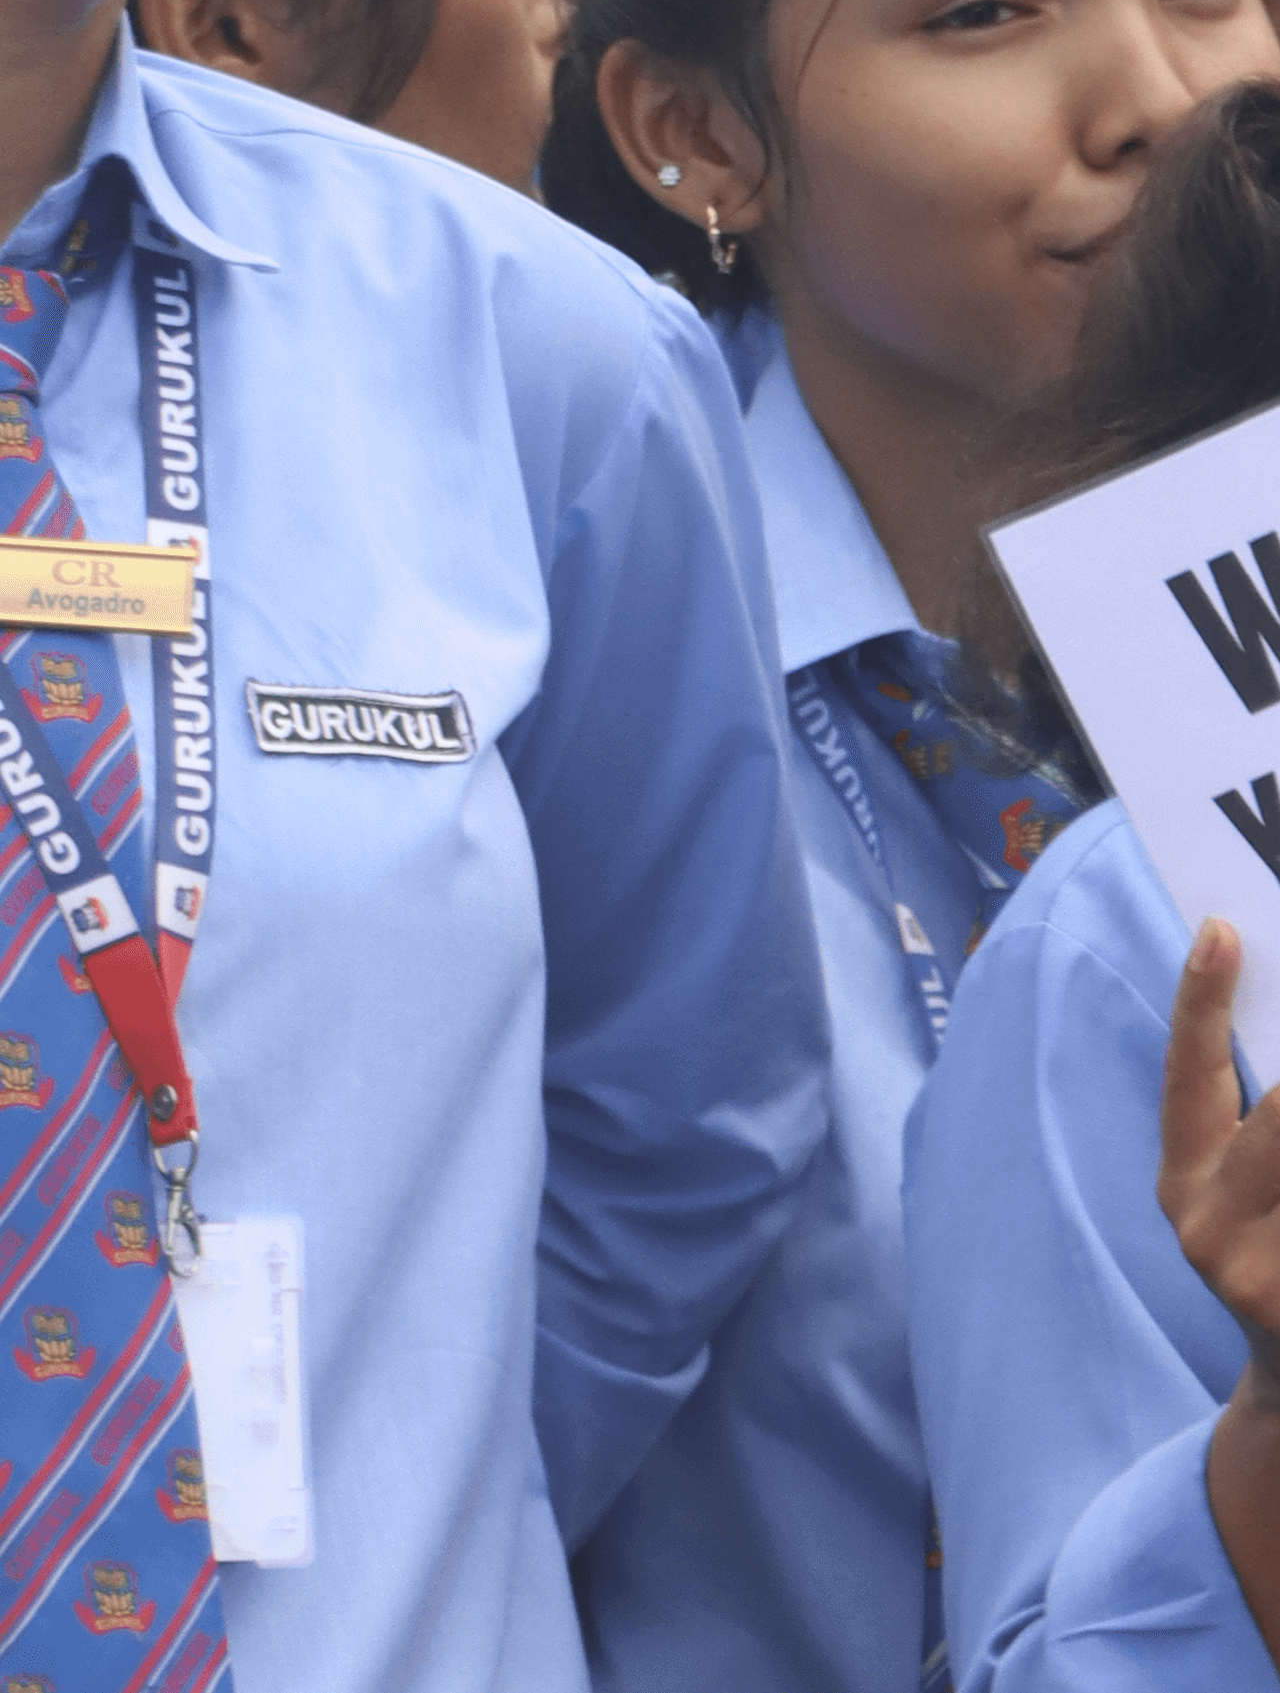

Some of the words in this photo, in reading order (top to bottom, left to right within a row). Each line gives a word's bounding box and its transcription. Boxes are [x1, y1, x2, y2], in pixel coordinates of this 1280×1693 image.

[154, 268, 200, 511] GURUKUL
[51, 558, 121, 588] CR
[26, 587, 145, 617] Avogadro
[261, 701, 460, 750] GURUKUL
